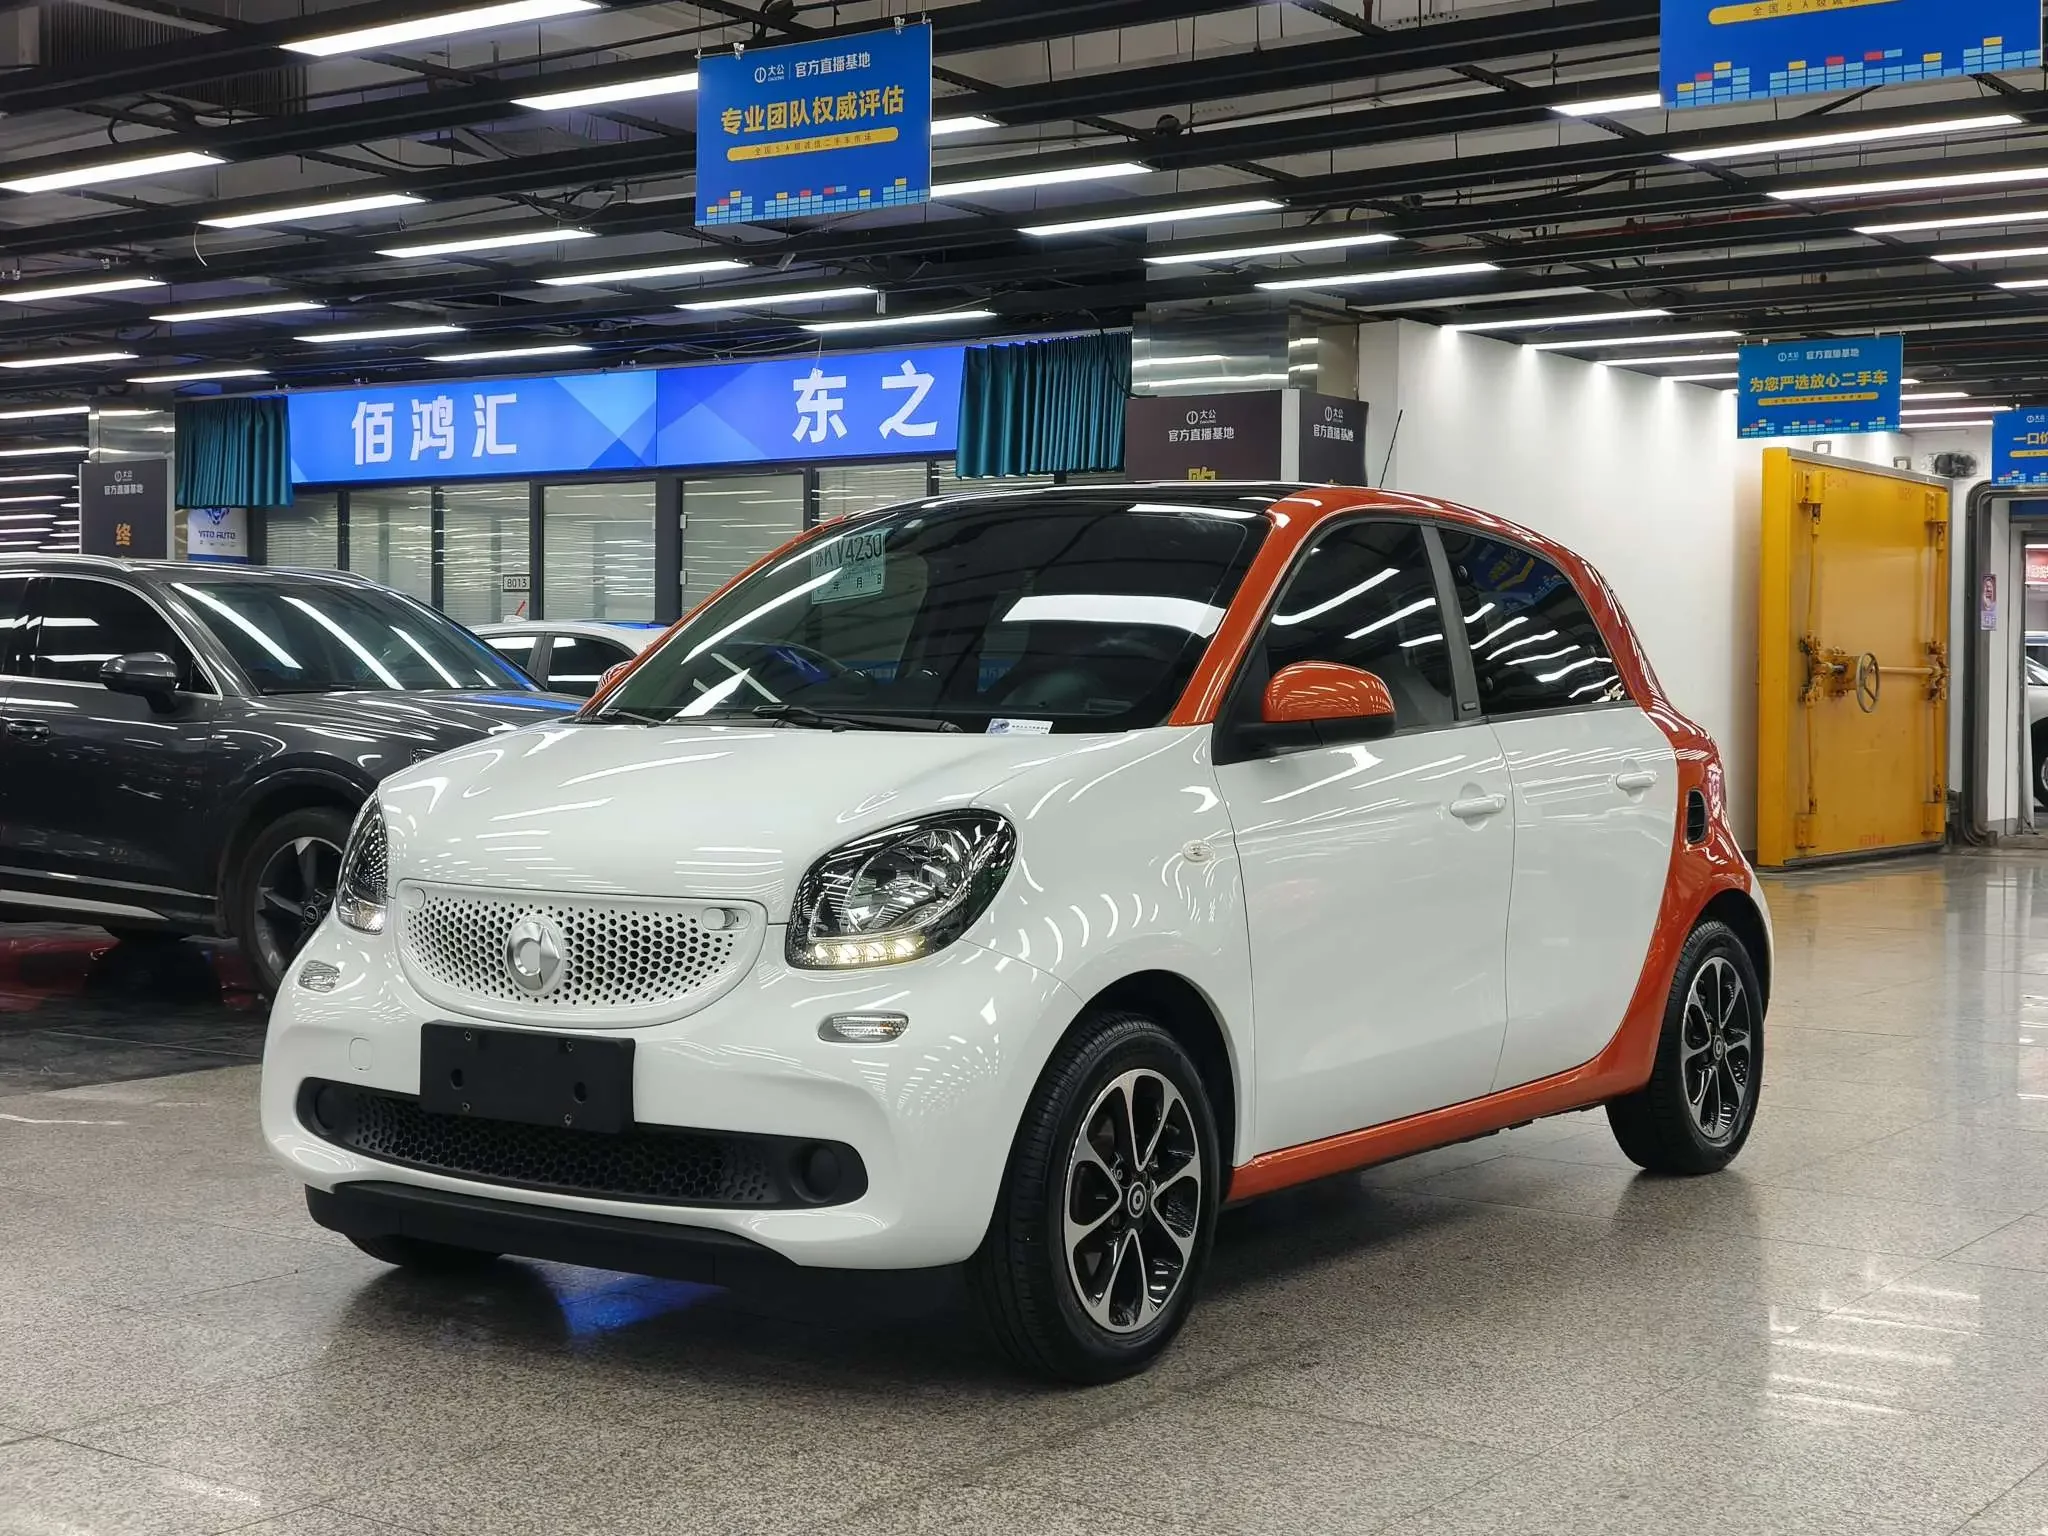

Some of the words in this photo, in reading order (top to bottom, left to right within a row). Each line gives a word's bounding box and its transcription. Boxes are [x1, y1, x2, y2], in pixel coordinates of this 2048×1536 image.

[768, 64, 784, 76] 大公
[795, 51, 871, 78] 官方直播基地
[720, 84, 905, 135] 专业团队权威评估
[1750, 369, 1888, 393] 为您严选放心二手车
[792, 360, 938, 443] 东之
[1200, 409, 1216, 419] 大公
[351, 393, 517, 466] 佰鸿汇
[1168, 426, 1235, 443] 官方直播基地
[1313, 424, 1354, 441] 官方直播基地
[216, 531, 236, 540] AUTO
[506, 578, 527, 588] 8013
